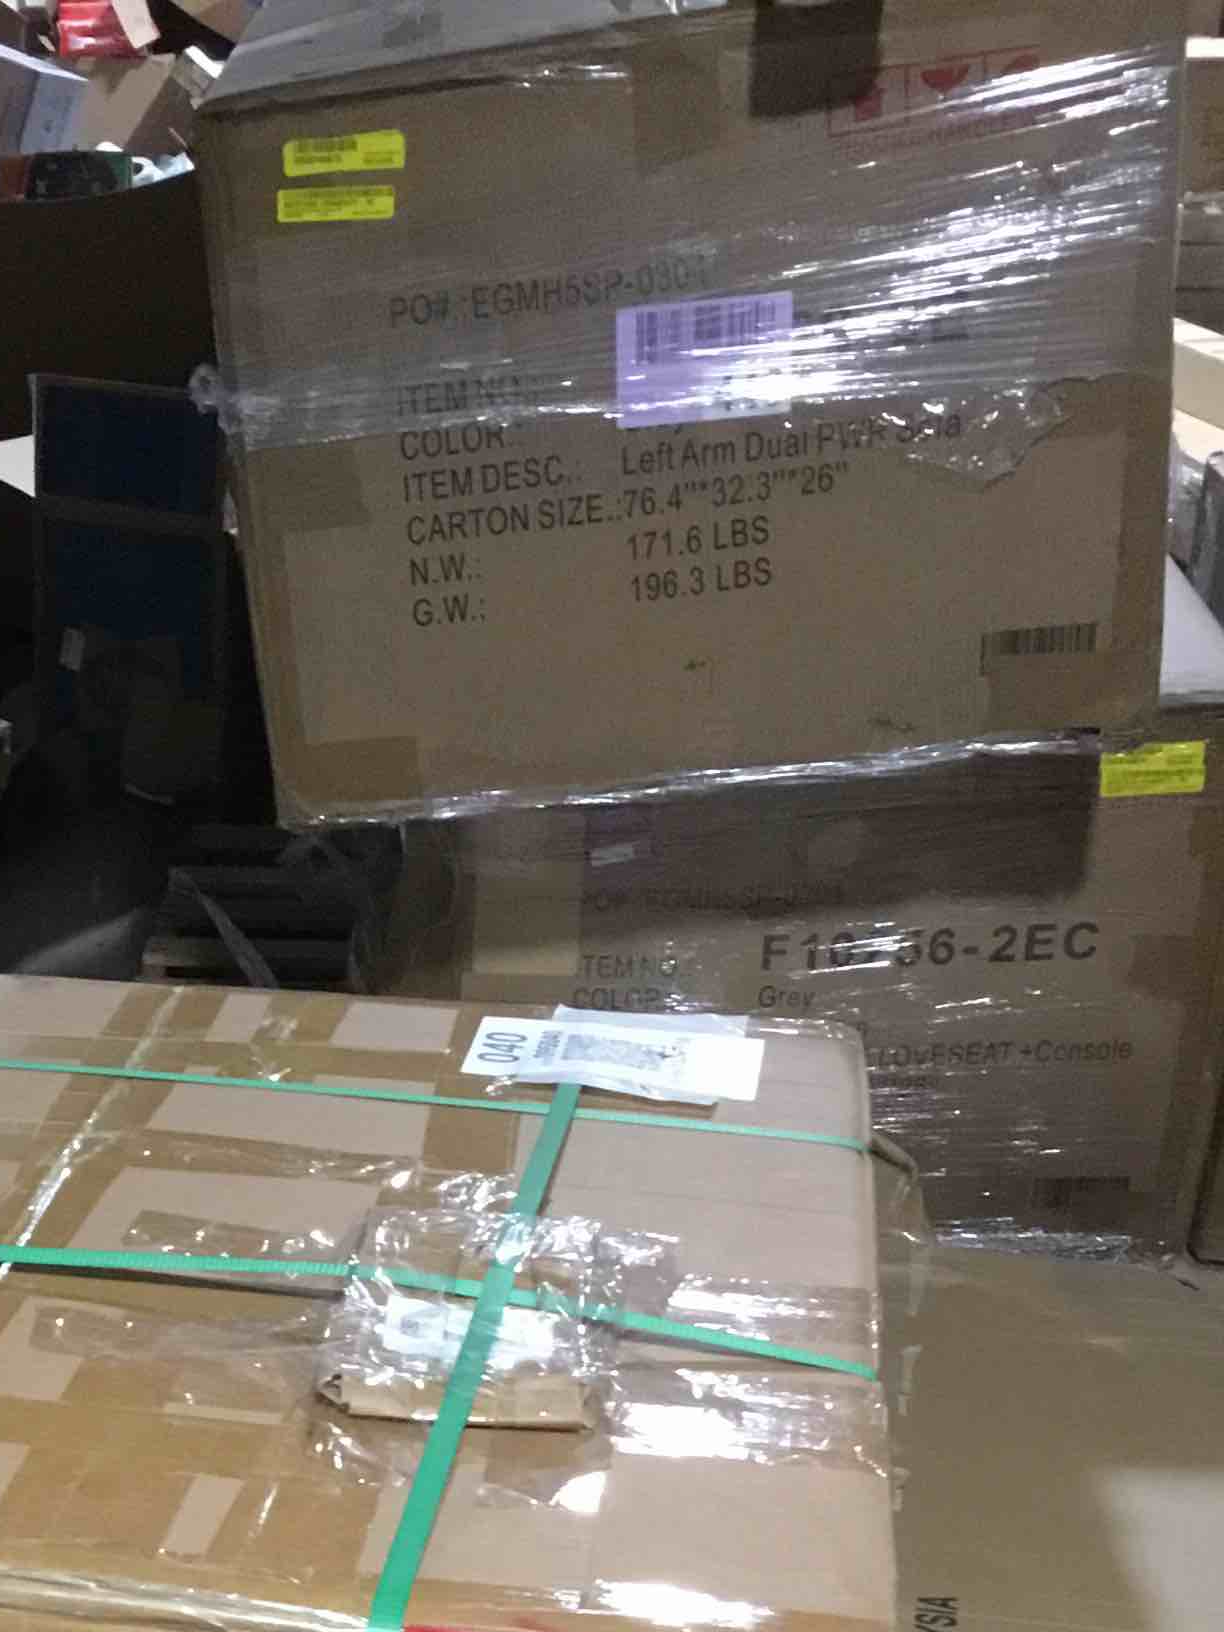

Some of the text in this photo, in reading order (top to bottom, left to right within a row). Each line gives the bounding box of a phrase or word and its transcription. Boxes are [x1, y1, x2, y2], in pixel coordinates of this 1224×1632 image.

[623, 440, 674, 475] Left
[681, 437, 736, 469] Arm
[745, 431, 808, 462] Dual
[403, 466, 473, 502] ITEM
[407, 504, 529, 545] CARTON
[628, 515, 770, 561] 171.6 LBS
[631, 557, 772, 601] 196.3 LBS
[758, 985, 816, 1011] Grey
[478, 1030, 528, 1064] 040
